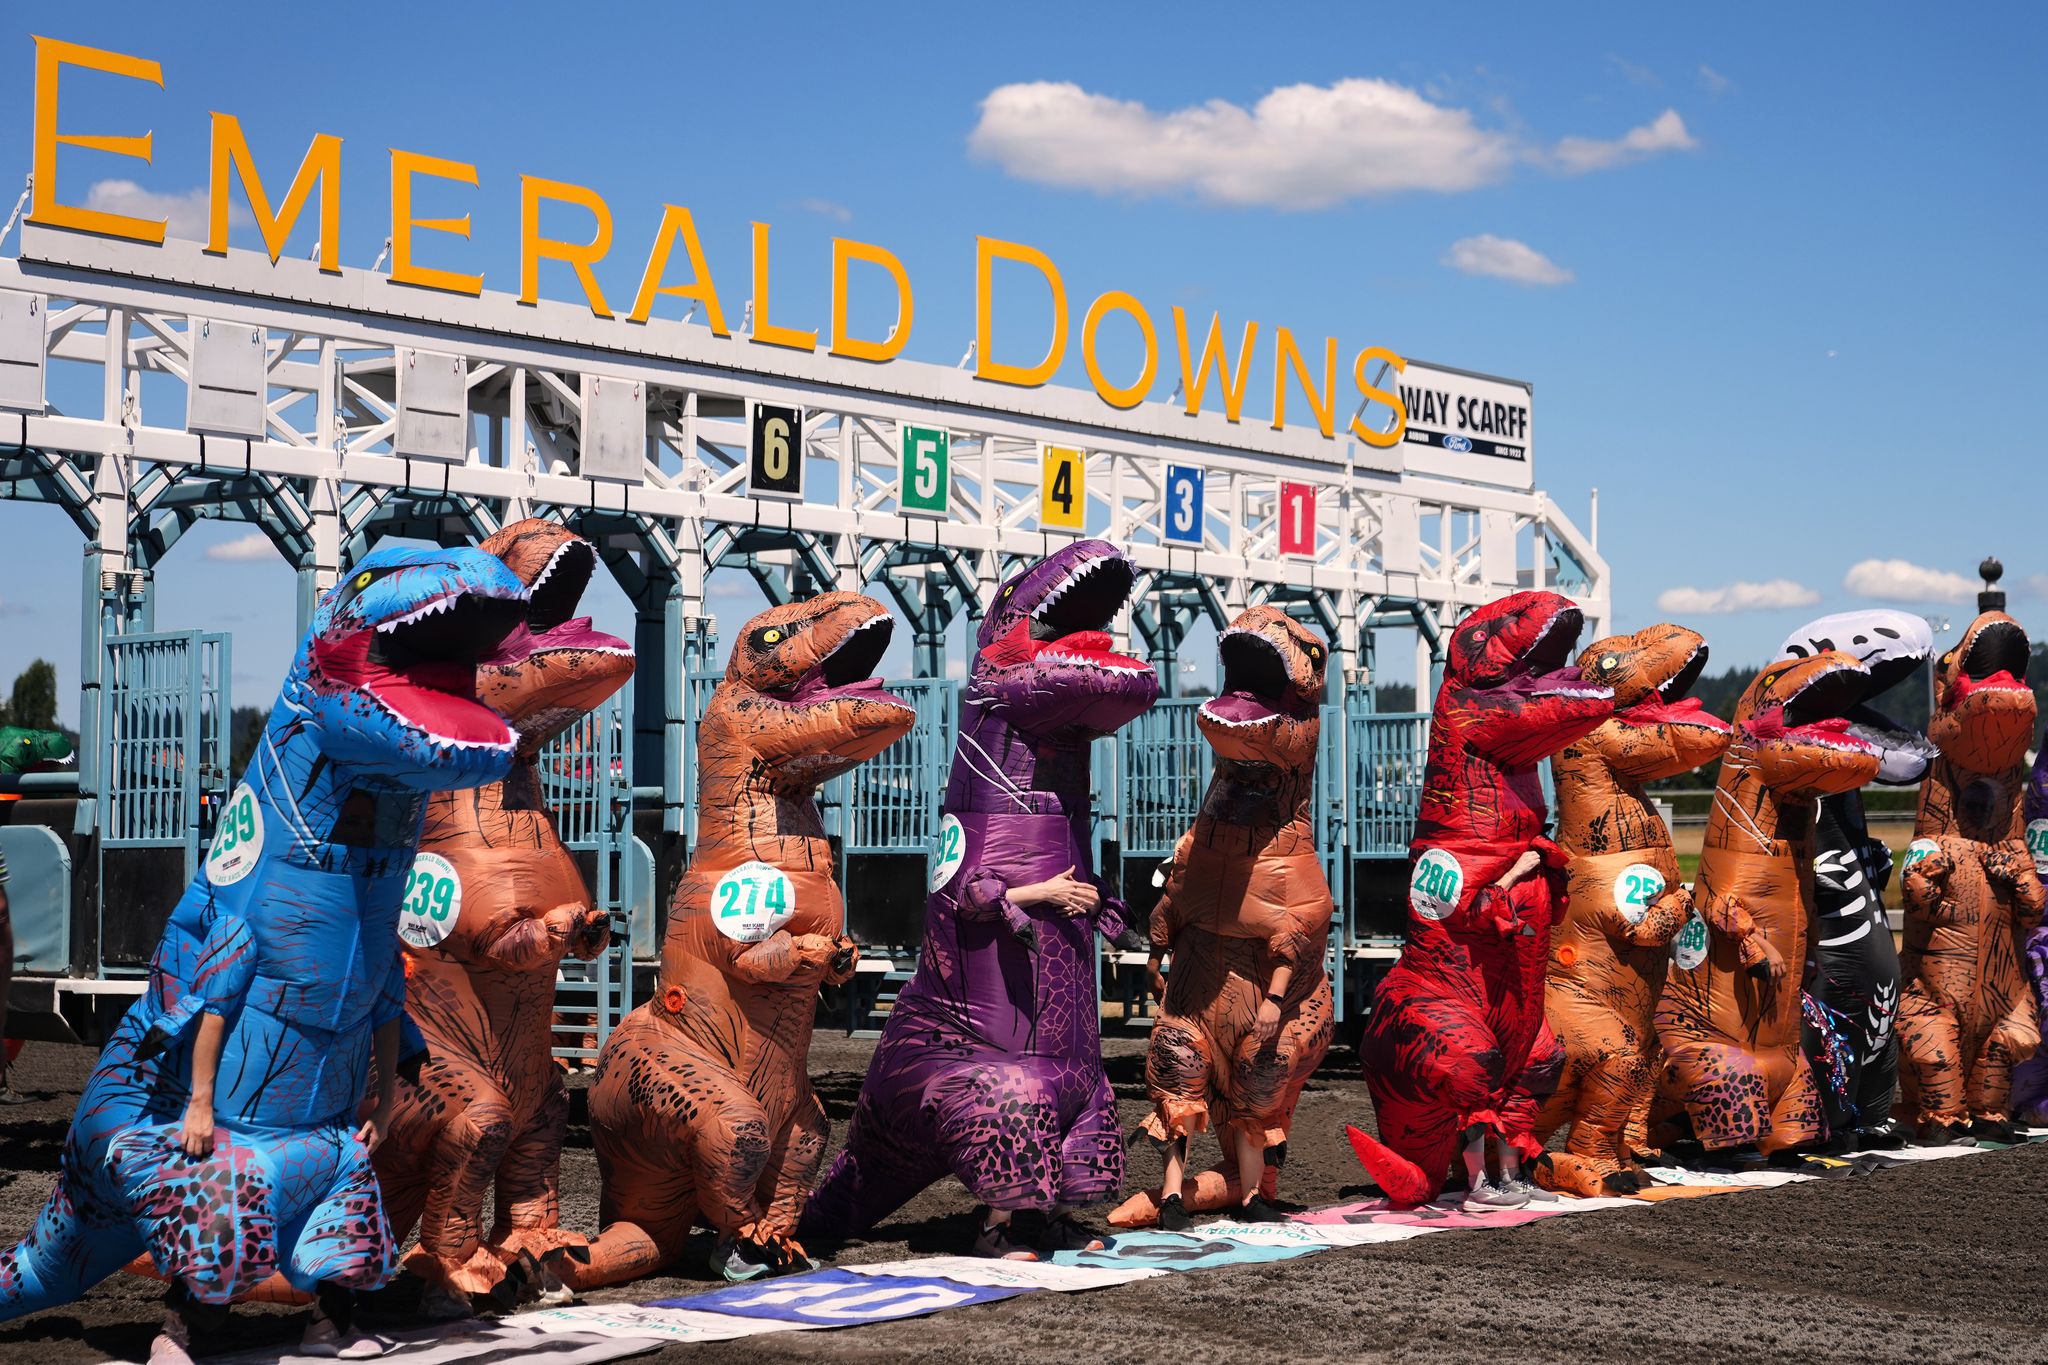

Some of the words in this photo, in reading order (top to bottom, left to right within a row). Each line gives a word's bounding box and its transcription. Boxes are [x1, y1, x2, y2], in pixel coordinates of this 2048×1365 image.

[23, 34, 914, 363] EMERALD
[972, 235, 1408, 448] DOWNS
[1400, 385, 1450, 426] WAY
[1456, 394, 1527, 440] SCARFF
[763, 417, 791, 481] 6
[915, 440, 938, 499] 5
[1449, 436, 1467, 451] Ford
[1051, 460, 1073, 515] 4
[1174, 479, 1194, 532] 3
[1291, 495, 1302, 545] 1
[402, 868, 454, 921] 239
[719, 877, 786, 918] 274
[1414, 858, 1459, 903] 280
